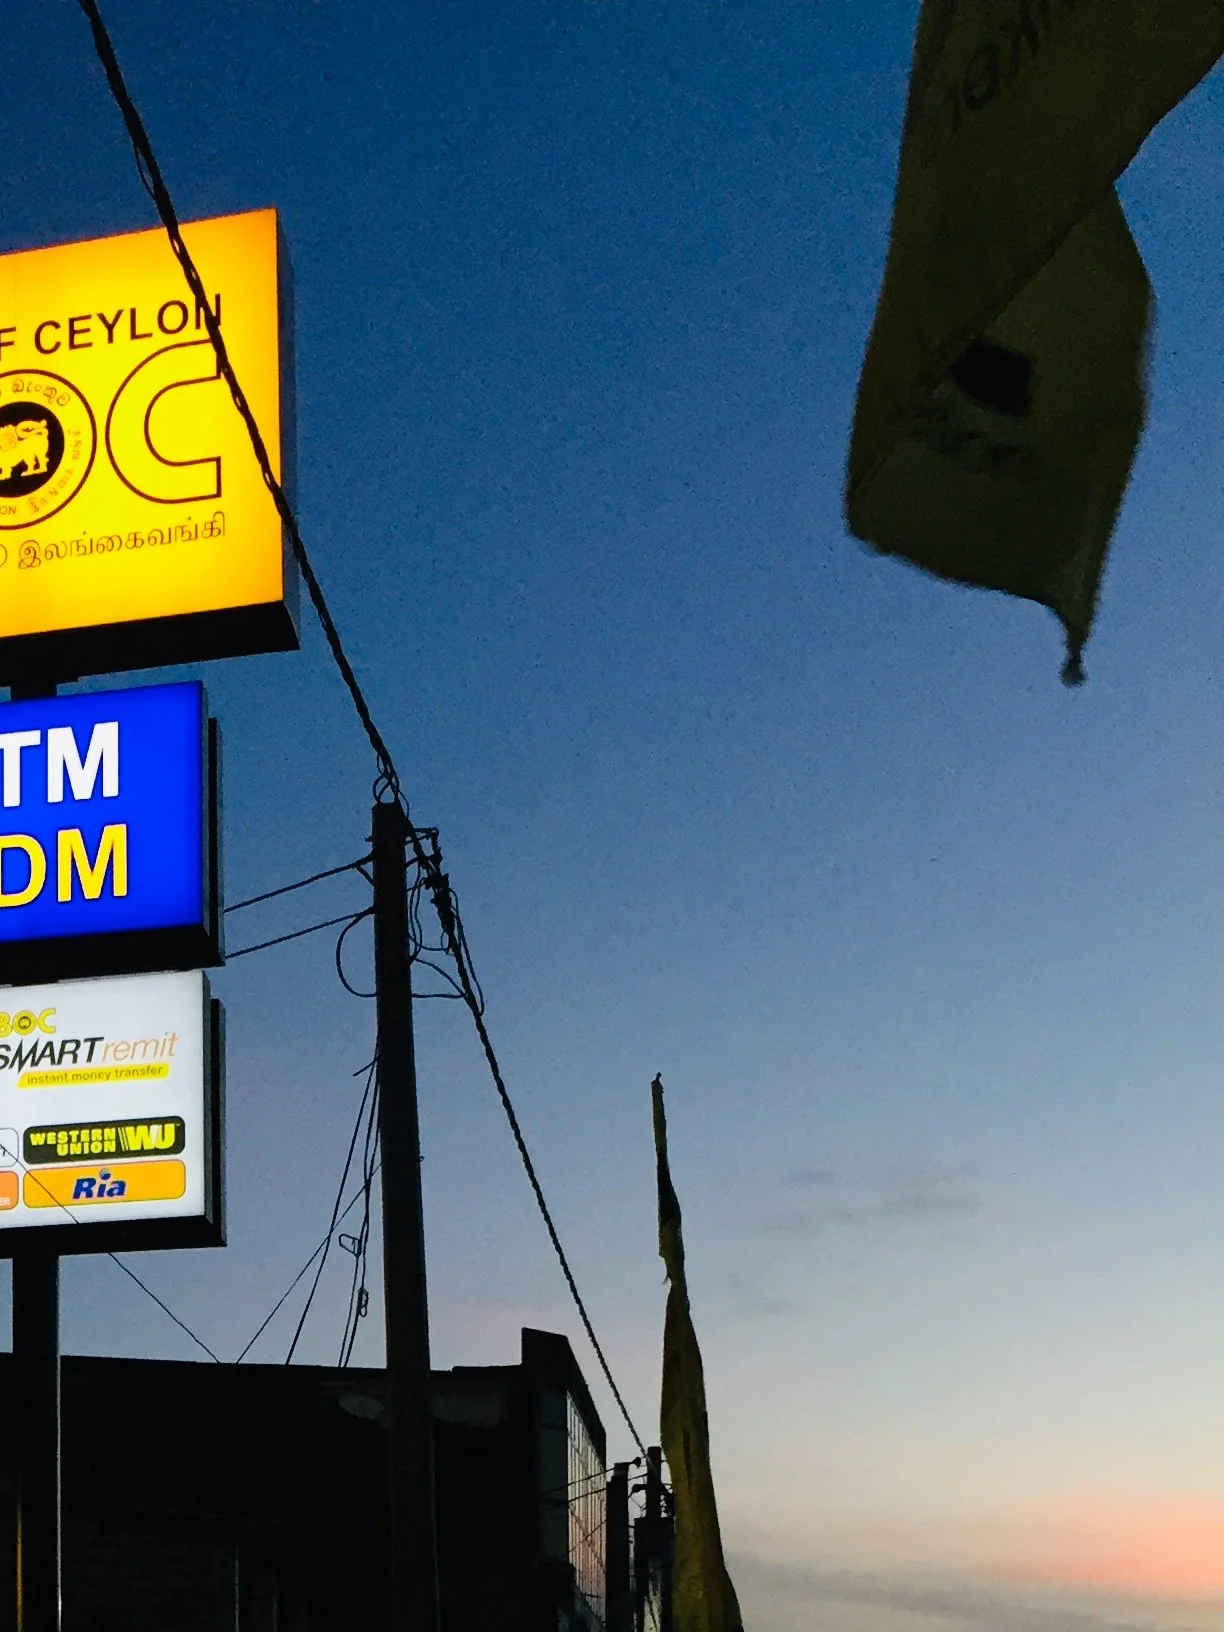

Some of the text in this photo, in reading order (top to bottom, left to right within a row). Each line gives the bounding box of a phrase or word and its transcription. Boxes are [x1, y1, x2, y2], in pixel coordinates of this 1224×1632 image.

[34, 293, 223, 355] CEYLON
[27, 1065, 163, 1085] instant money transfer
[29, 1127, 116, 1146] WESTERN
[125, 1122, 176, 1151] WU
[56, 1141, 116, 1157] UNION
[72, 1168, 127, 1200] Ria
